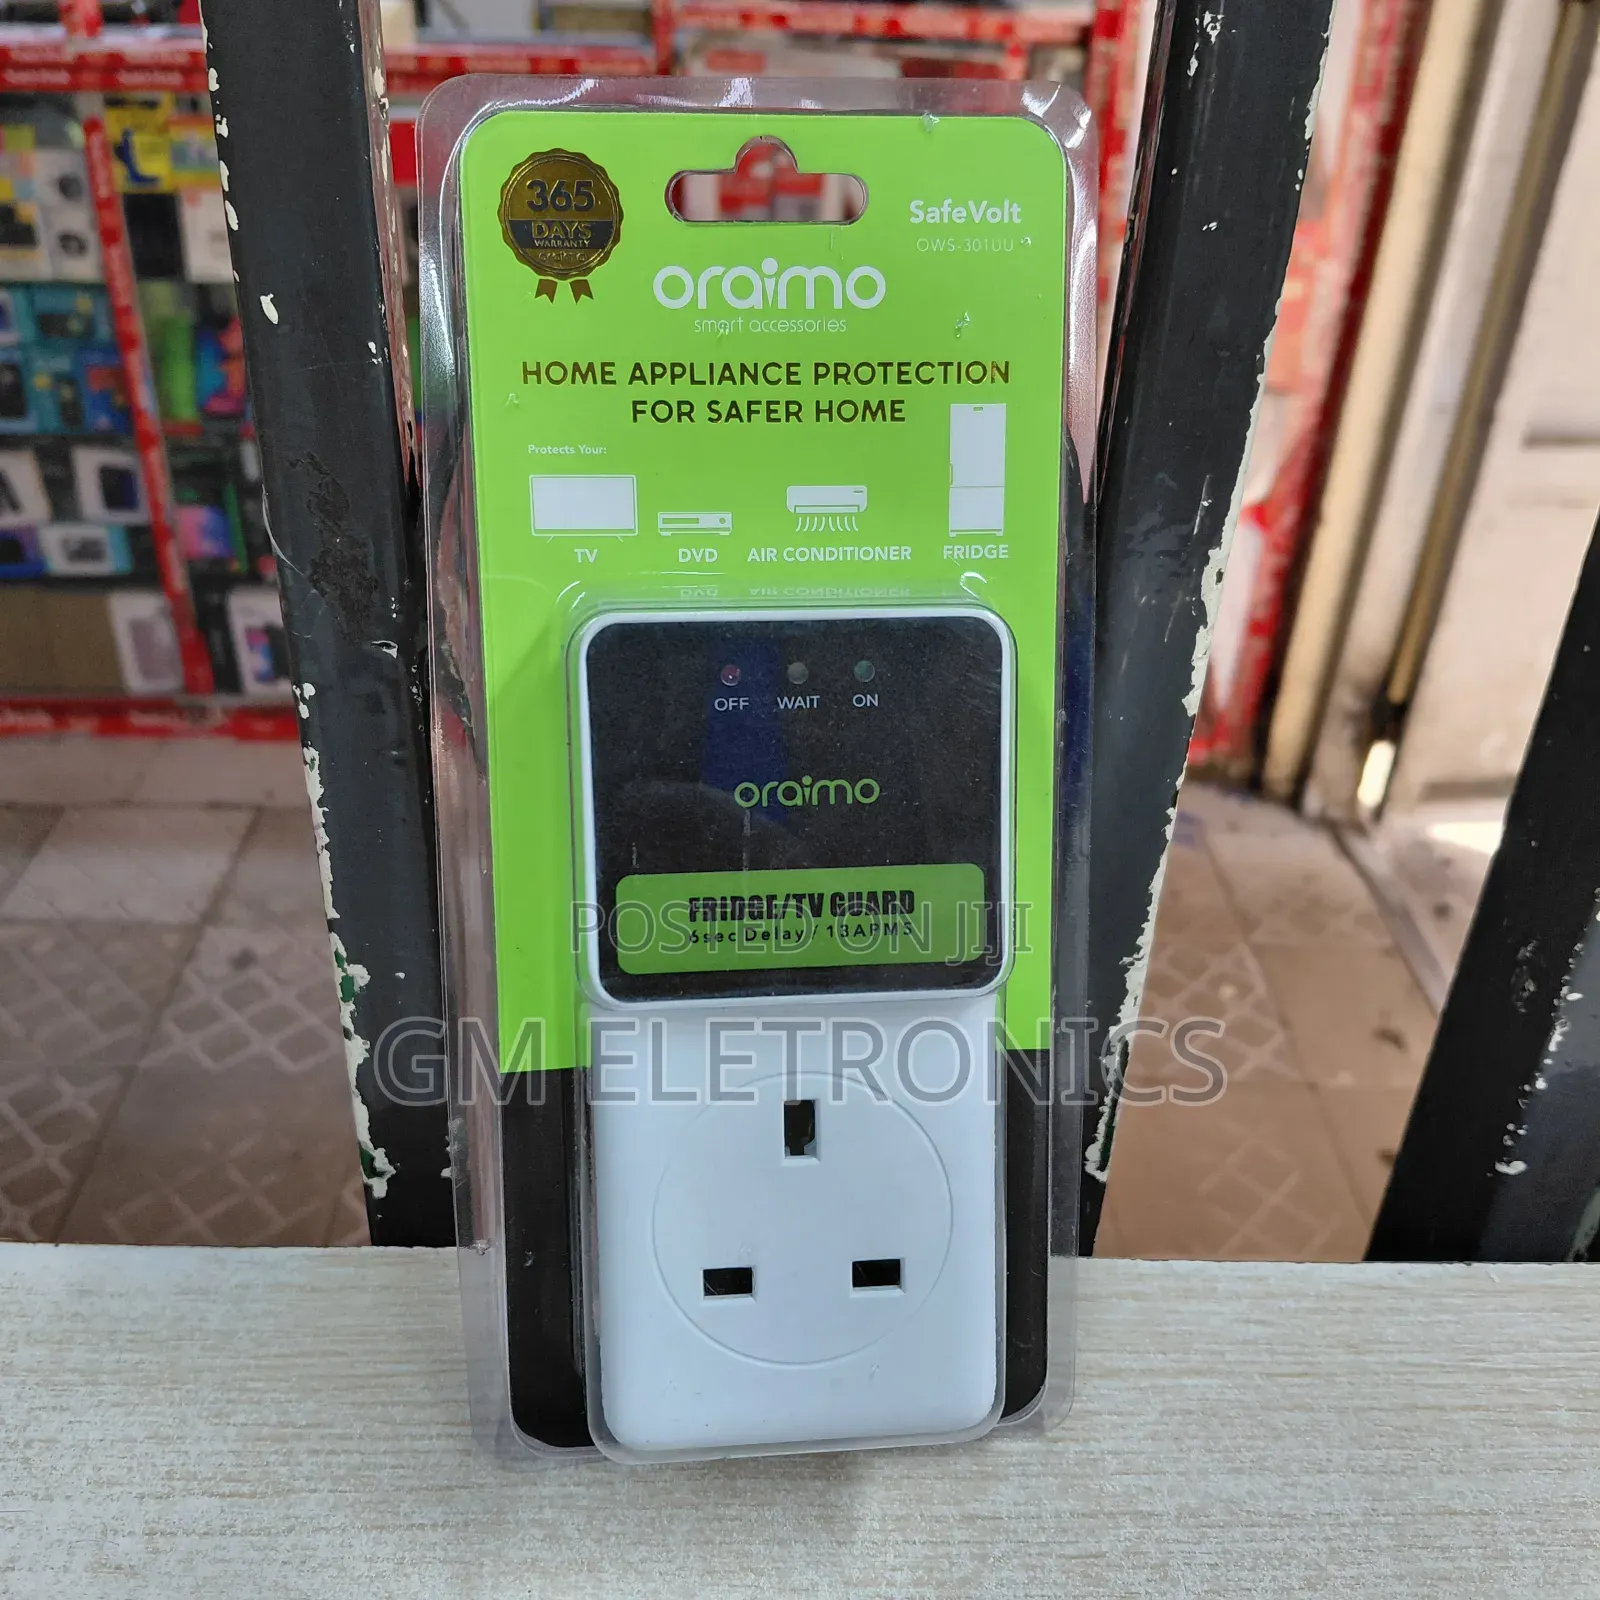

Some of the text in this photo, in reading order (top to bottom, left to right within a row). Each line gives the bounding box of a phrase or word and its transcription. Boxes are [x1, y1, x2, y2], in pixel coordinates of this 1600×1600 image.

[526, 179, 596, 212] 365
[909, 198, 1022, 224] SafeVolt
[531, 221, 592, 239] DAYS
[534, 239, 590, 248] WARRANTY
[916, 238, 1014, 252] OWS-301UU
[653, 257, 886, 310] oraimo
[694, 317, 847, 336] smart accessories
[522, 361, 1010, 386] HOME APPLIANCE PROTECTION
[632, 400, 906, 424] FOR SAFER HOME
[528, 444, 607, 455] Protects Your:
[574, 548, 598, 563] TV
[678, 548, 718, 563] DVD
[747, 546, 912, 562] AIR CONDITIONER
[943, 544, 1009, 560] FRIDGE
[714, 697, 749, 711] OFF
[777, 695, 820, 709] WAIT
[852, 694, 879, 708] ON
[734, 775, 880, 808] oraimo
[688, 890, 915, 922] FRIDGE/TV GUARD
